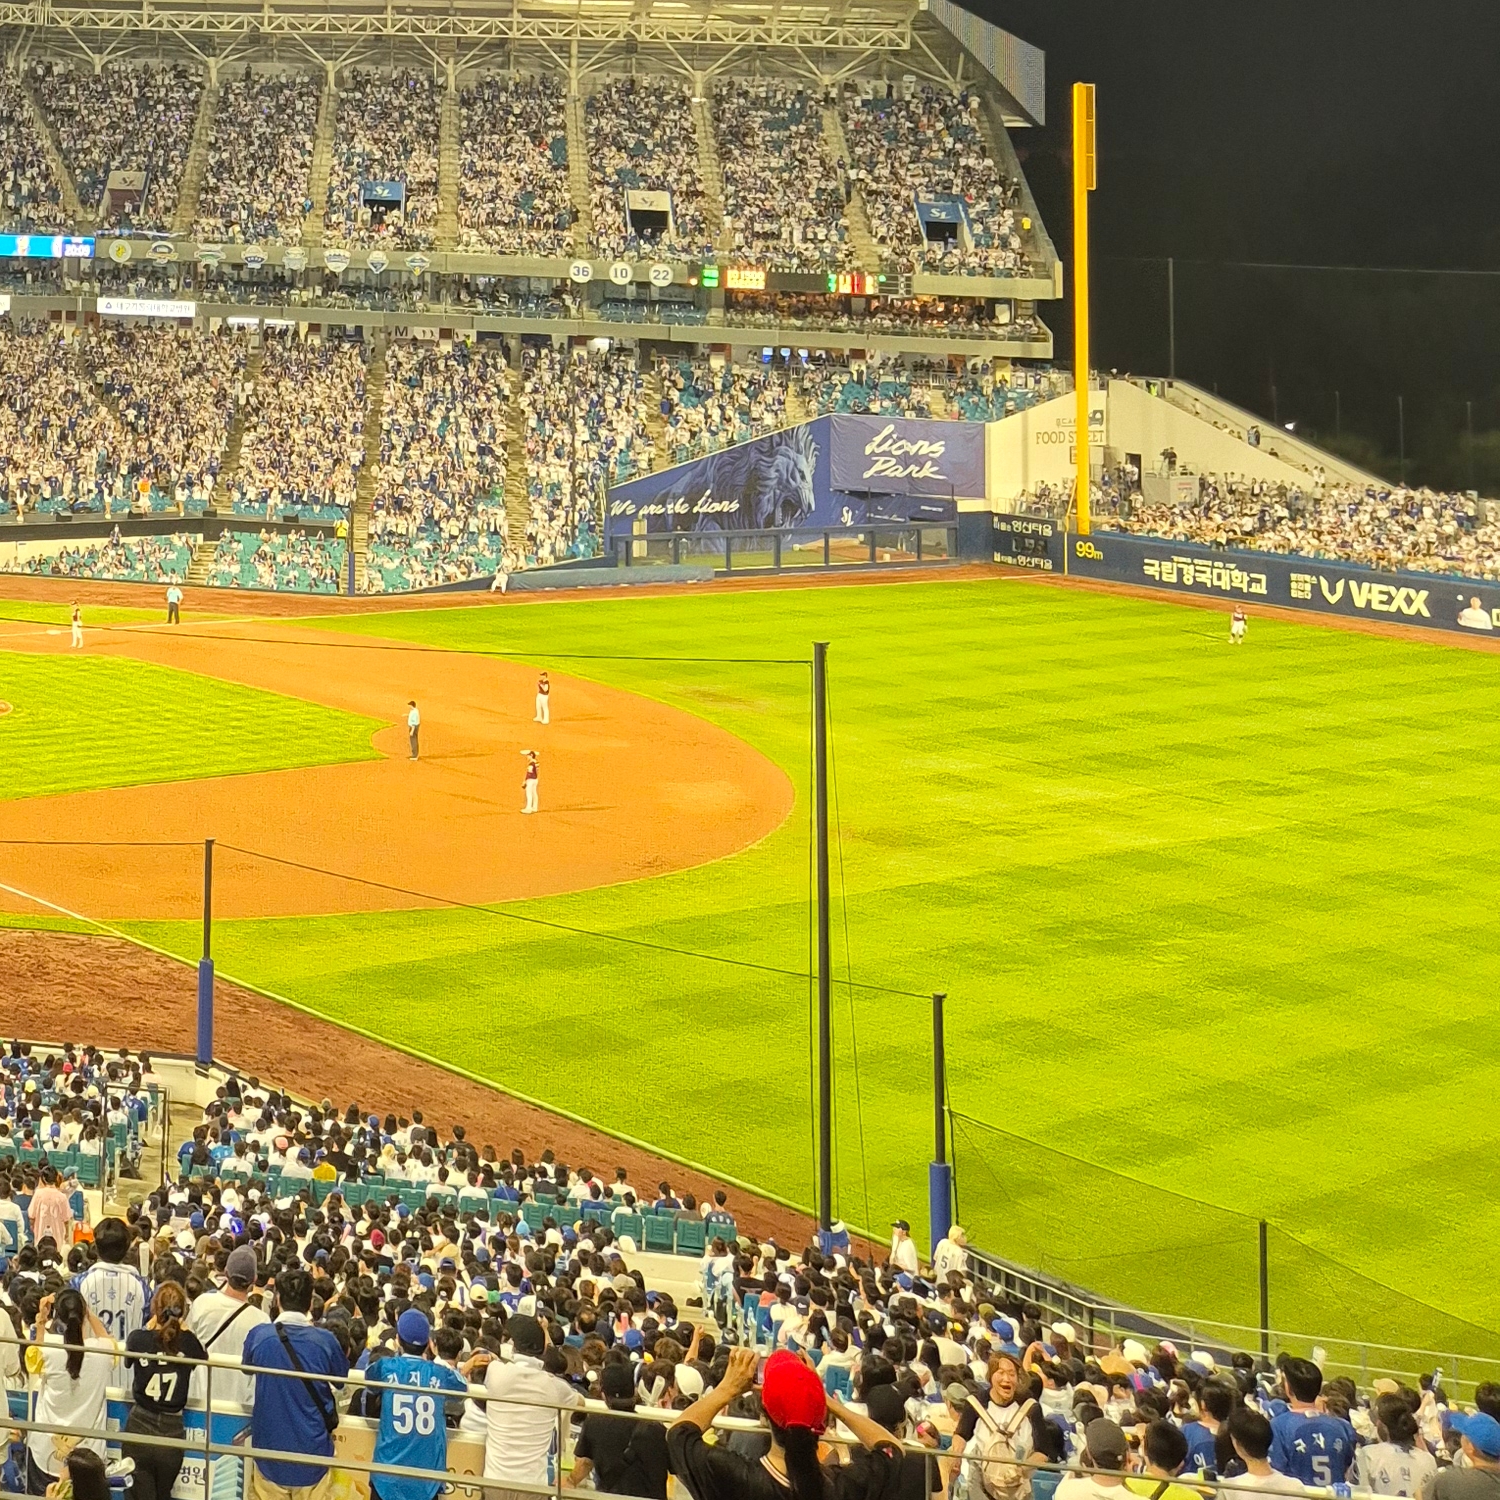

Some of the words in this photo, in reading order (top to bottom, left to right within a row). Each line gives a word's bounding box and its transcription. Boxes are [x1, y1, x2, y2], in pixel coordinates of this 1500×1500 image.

[572, 266, 590, 277] 36
[614, 268, 628, 278] 10
[653, 270, 669, 281] 22
[864, 424, 946, 458] Lions
[1036, 431, 1065, 445] FOOD
[862, 456, 949, 480] Park
[610, 499, 636, 517] We
[693, 488, 739, 515] Lions
[1076, 541, 1103, 560] 99m
[1143, 558, 1267, 595] 국립경국대학교
[1349, 579, 1431, 618] VEXX
[940, 1255, 949, 1270] 5
[145, 1372, 178, 1402] 47
[392, 1394, 435, 1436] 58
[1311, 1455, 1331, 1486] 5
